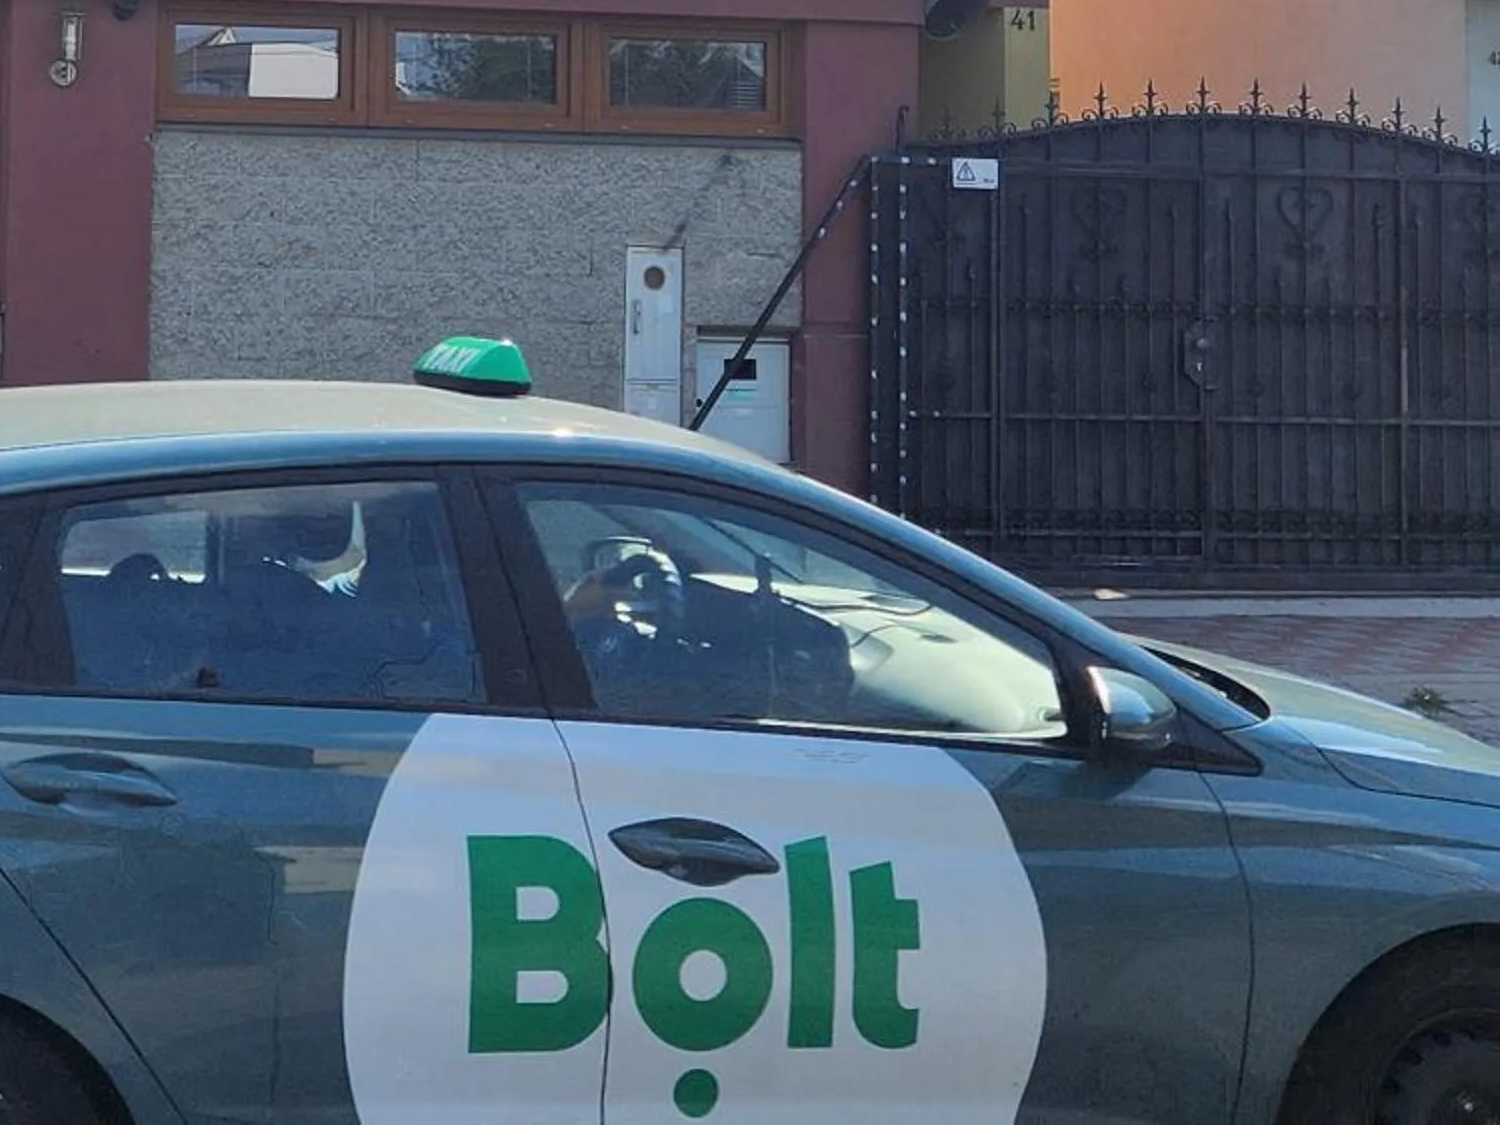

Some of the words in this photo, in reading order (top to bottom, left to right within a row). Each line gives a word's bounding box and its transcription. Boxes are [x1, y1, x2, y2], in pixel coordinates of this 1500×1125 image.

[1011, 8, 1035, 31] 41
[419, 342, 480, 374] TAXI
[466, 834, 920, 1053] Bolt
